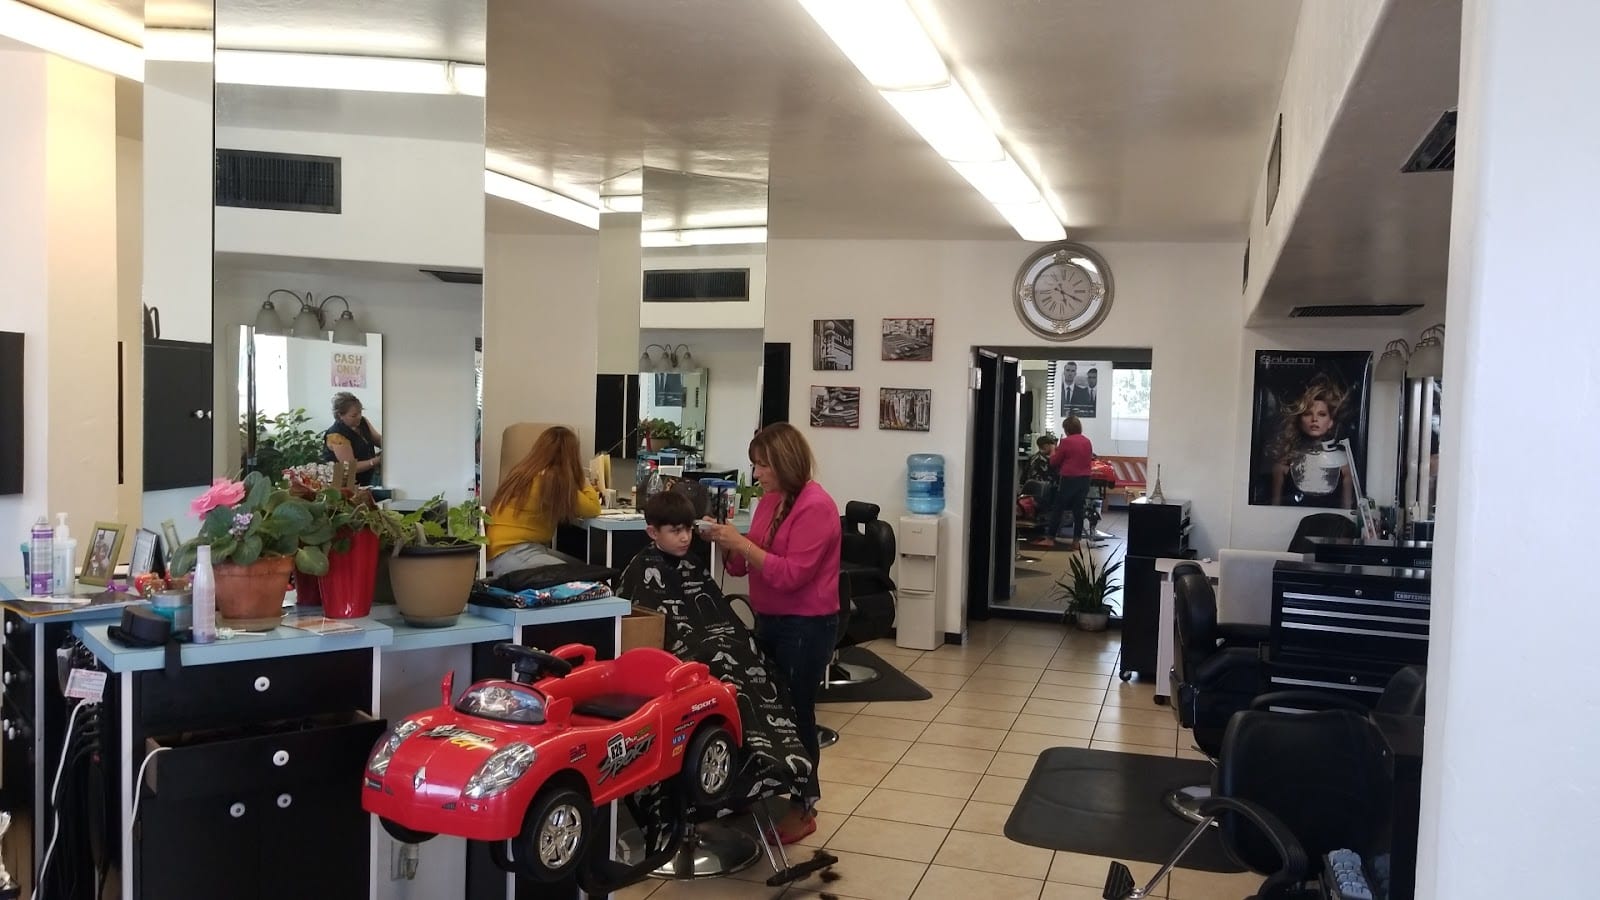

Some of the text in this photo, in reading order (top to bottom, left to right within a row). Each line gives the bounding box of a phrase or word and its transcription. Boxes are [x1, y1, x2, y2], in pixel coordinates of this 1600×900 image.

[334, 353, 362, 364] CASH
[336, 365, 361, 375] ONLY
[691, 697, 717, 712] Sport
